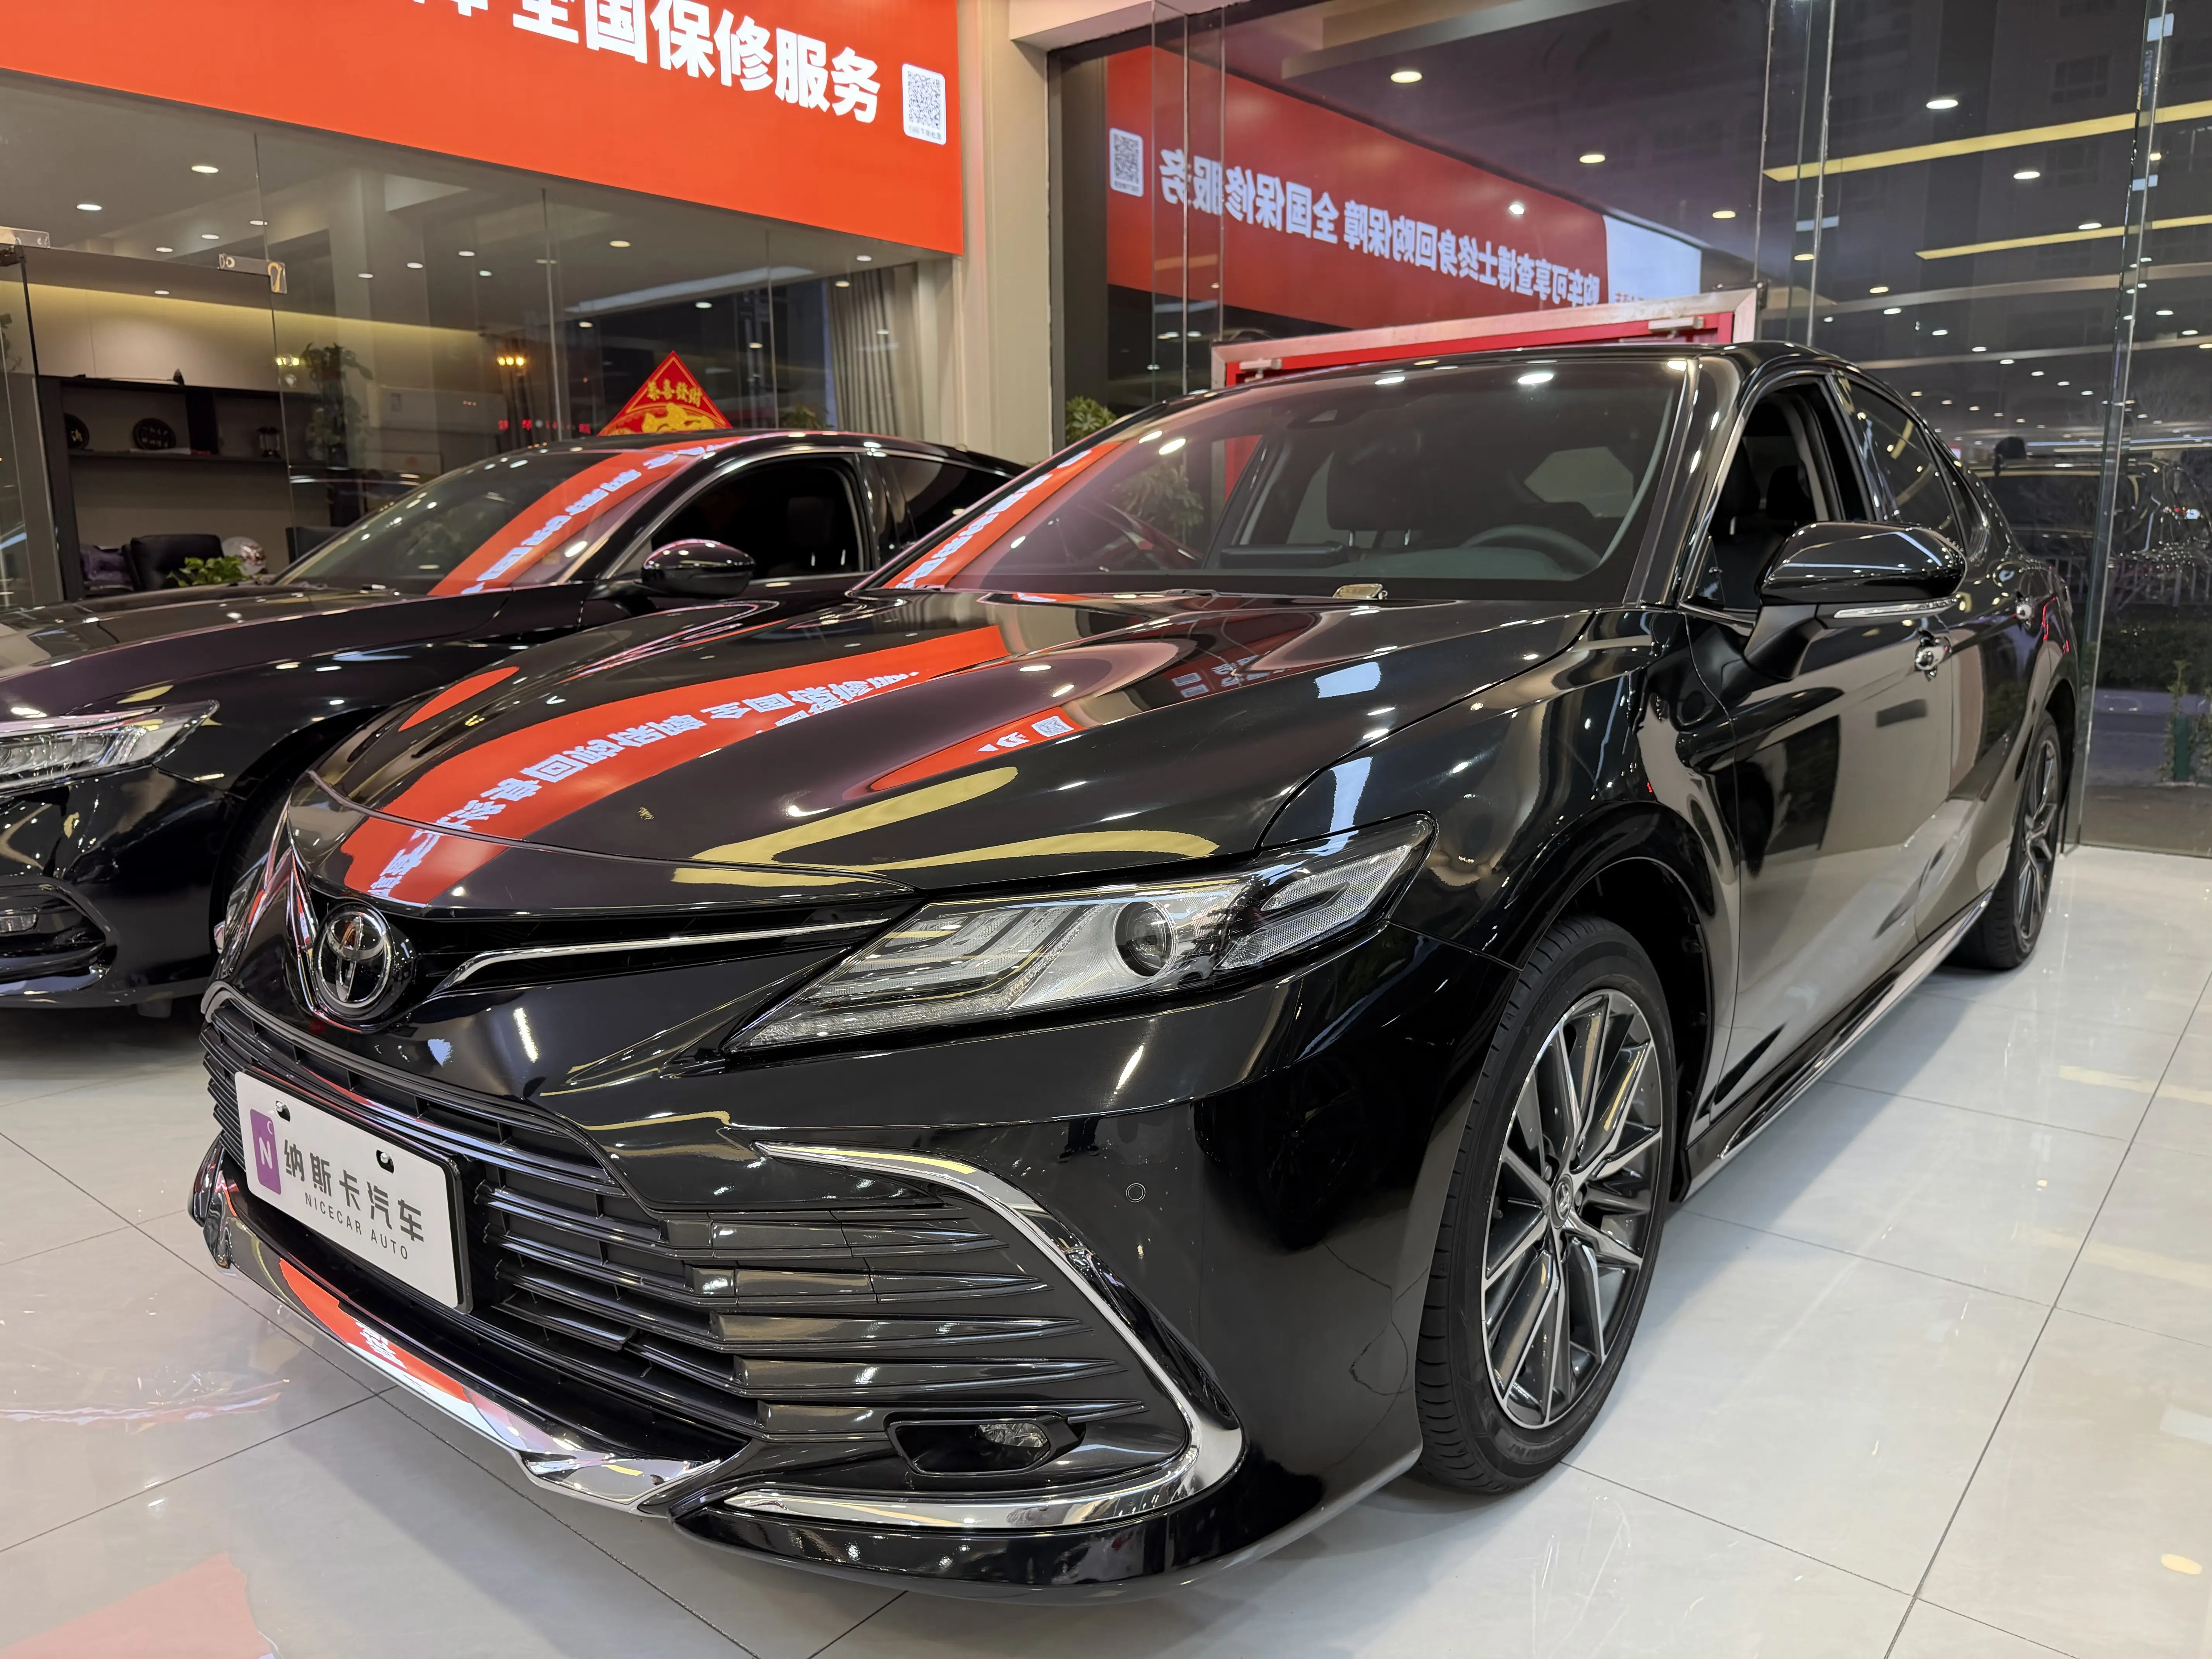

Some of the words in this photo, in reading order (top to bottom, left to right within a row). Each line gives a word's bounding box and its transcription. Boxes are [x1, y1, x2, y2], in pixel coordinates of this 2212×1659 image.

[284, 1139, 424, 1242] 纳斯卡汽车
[305, 1192, 362, 1235] NICECAR
[371, 1229, 408, 1260] AUTO
